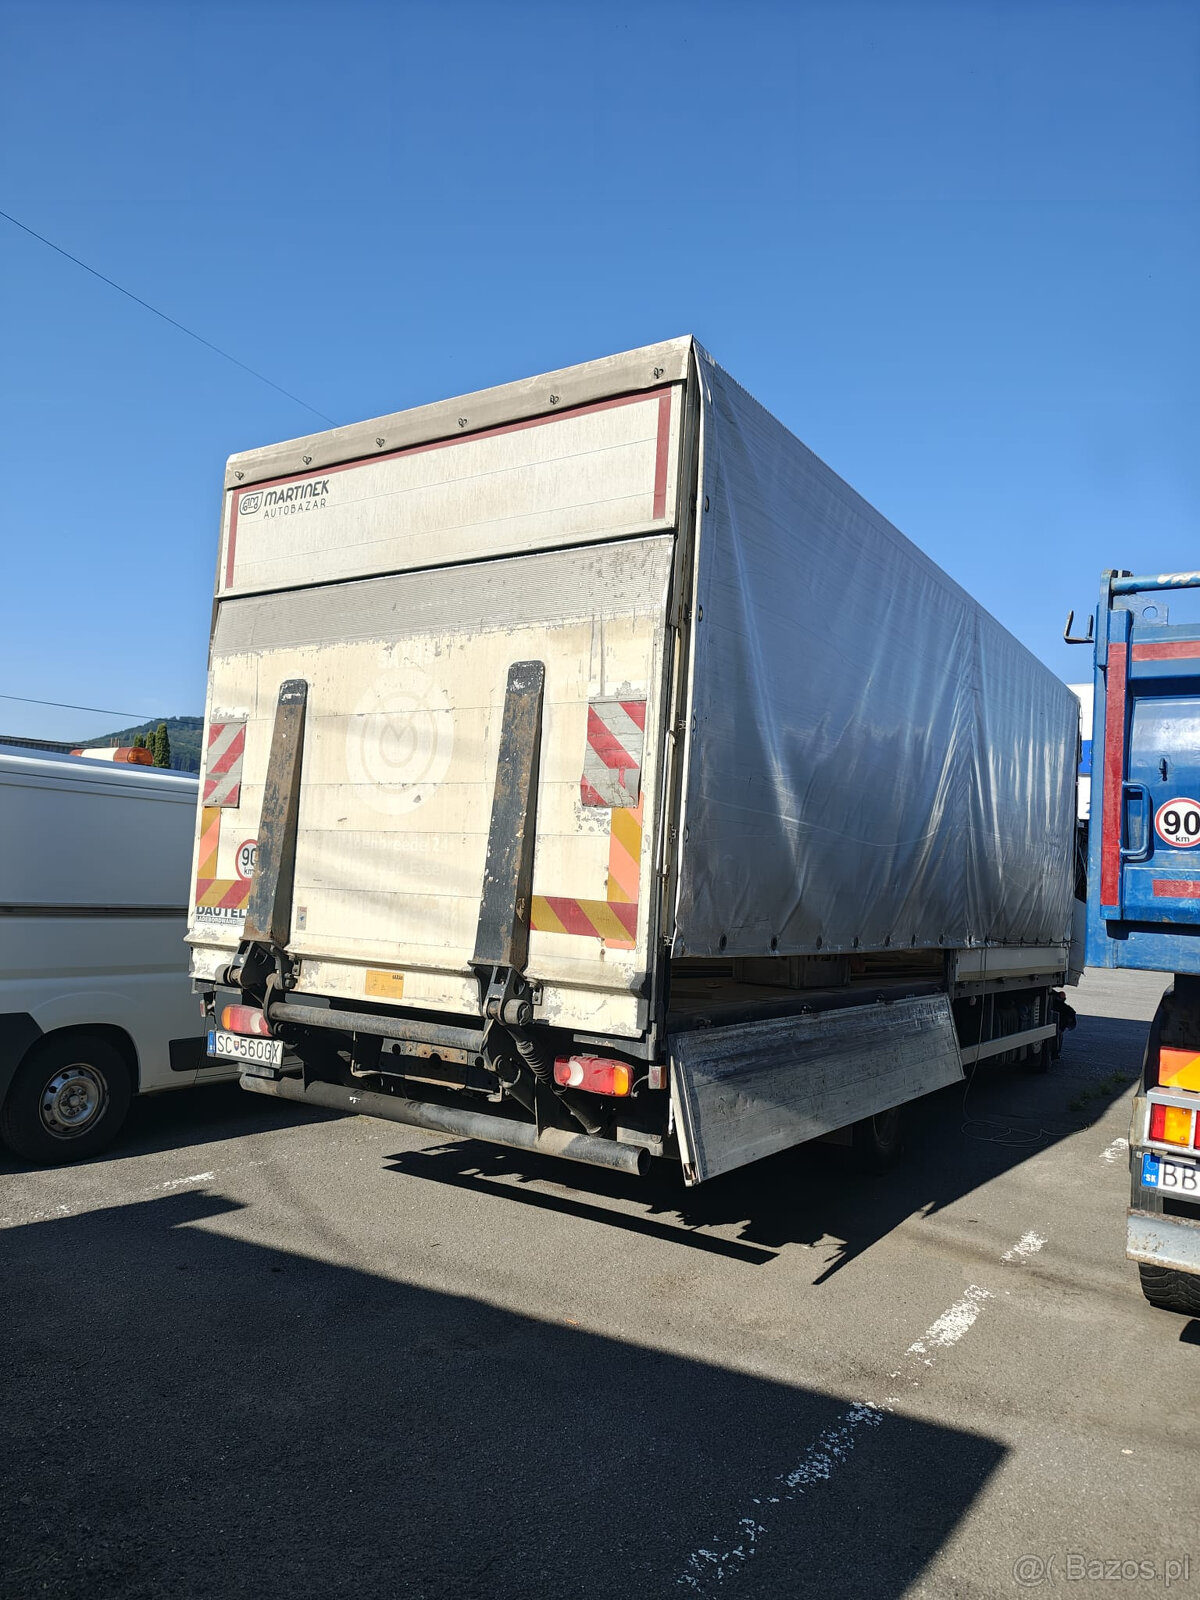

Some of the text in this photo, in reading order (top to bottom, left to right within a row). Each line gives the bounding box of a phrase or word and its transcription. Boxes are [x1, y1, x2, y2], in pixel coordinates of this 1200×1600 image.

[264, 480, 330, 506] MARTINEK
[264, 498, 327, 519] AUTOBAZAR
[1163, 810, 1200, 836] 90
[196, 906, 246, 918] DAUTEL
[217, 1035, 232, 1054] SC
[1145, 1161, 1198, 1191] SK BB
